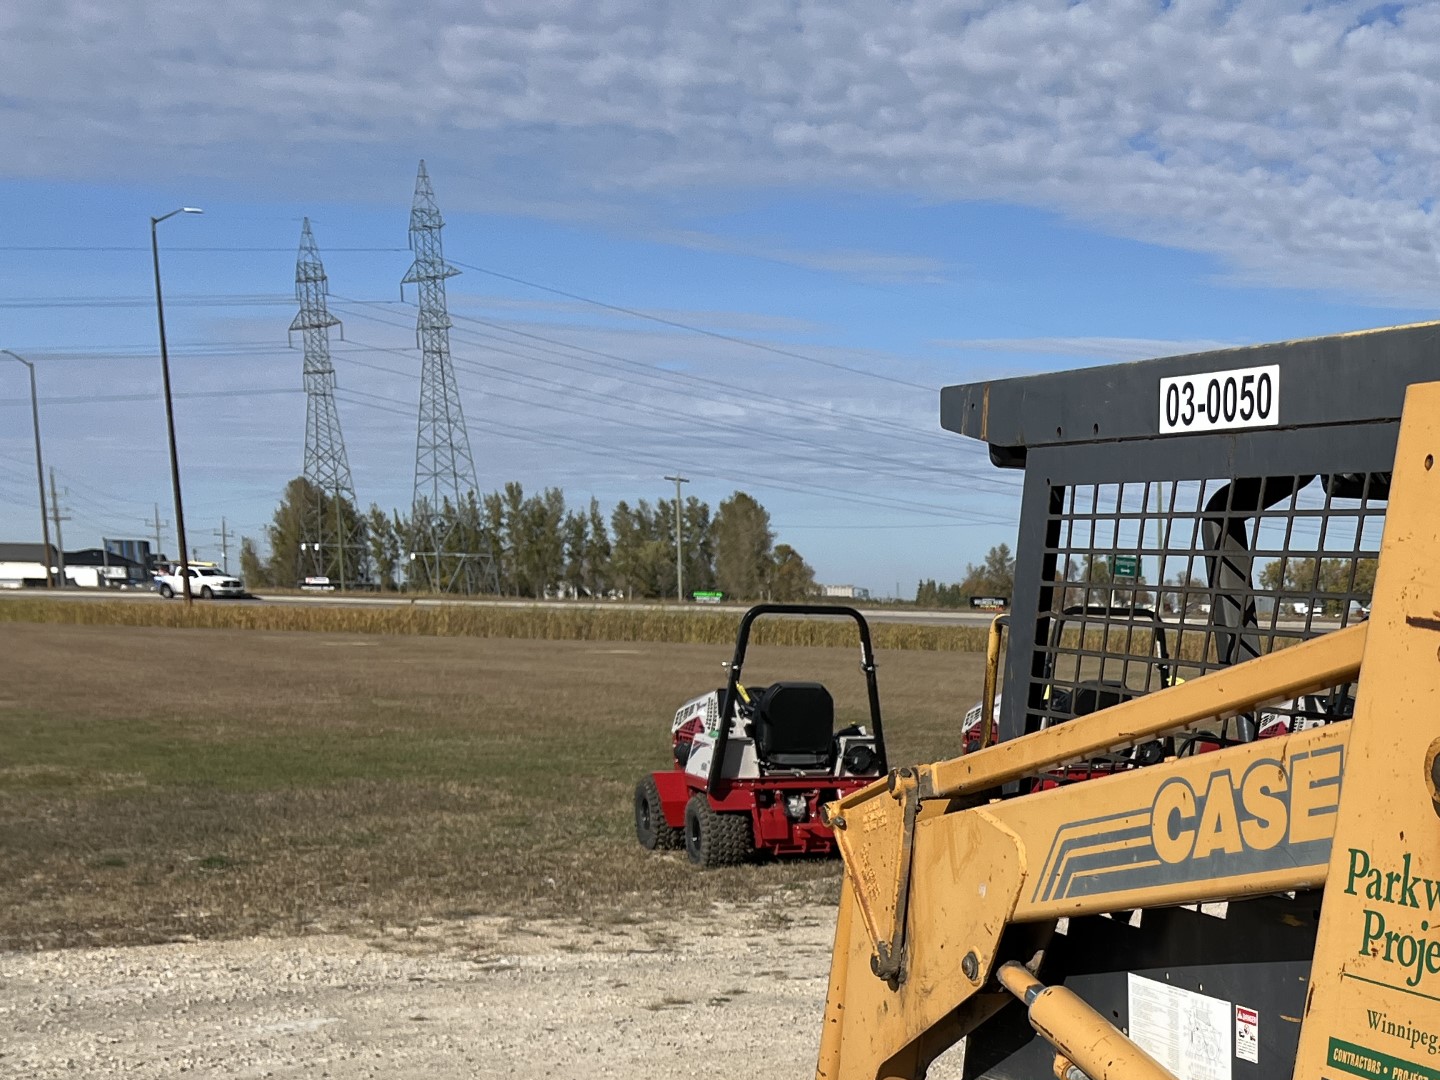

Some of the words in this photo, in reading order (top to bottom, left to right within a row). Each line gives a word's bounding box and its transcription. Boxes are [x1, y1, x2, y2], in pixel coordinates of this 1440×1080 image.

[1166, 374, 1273, 427] 03-0050
[1151, 746, 1343, 865] CASE
[1332, 1047, 1382, 1075] CONTRACTORS
